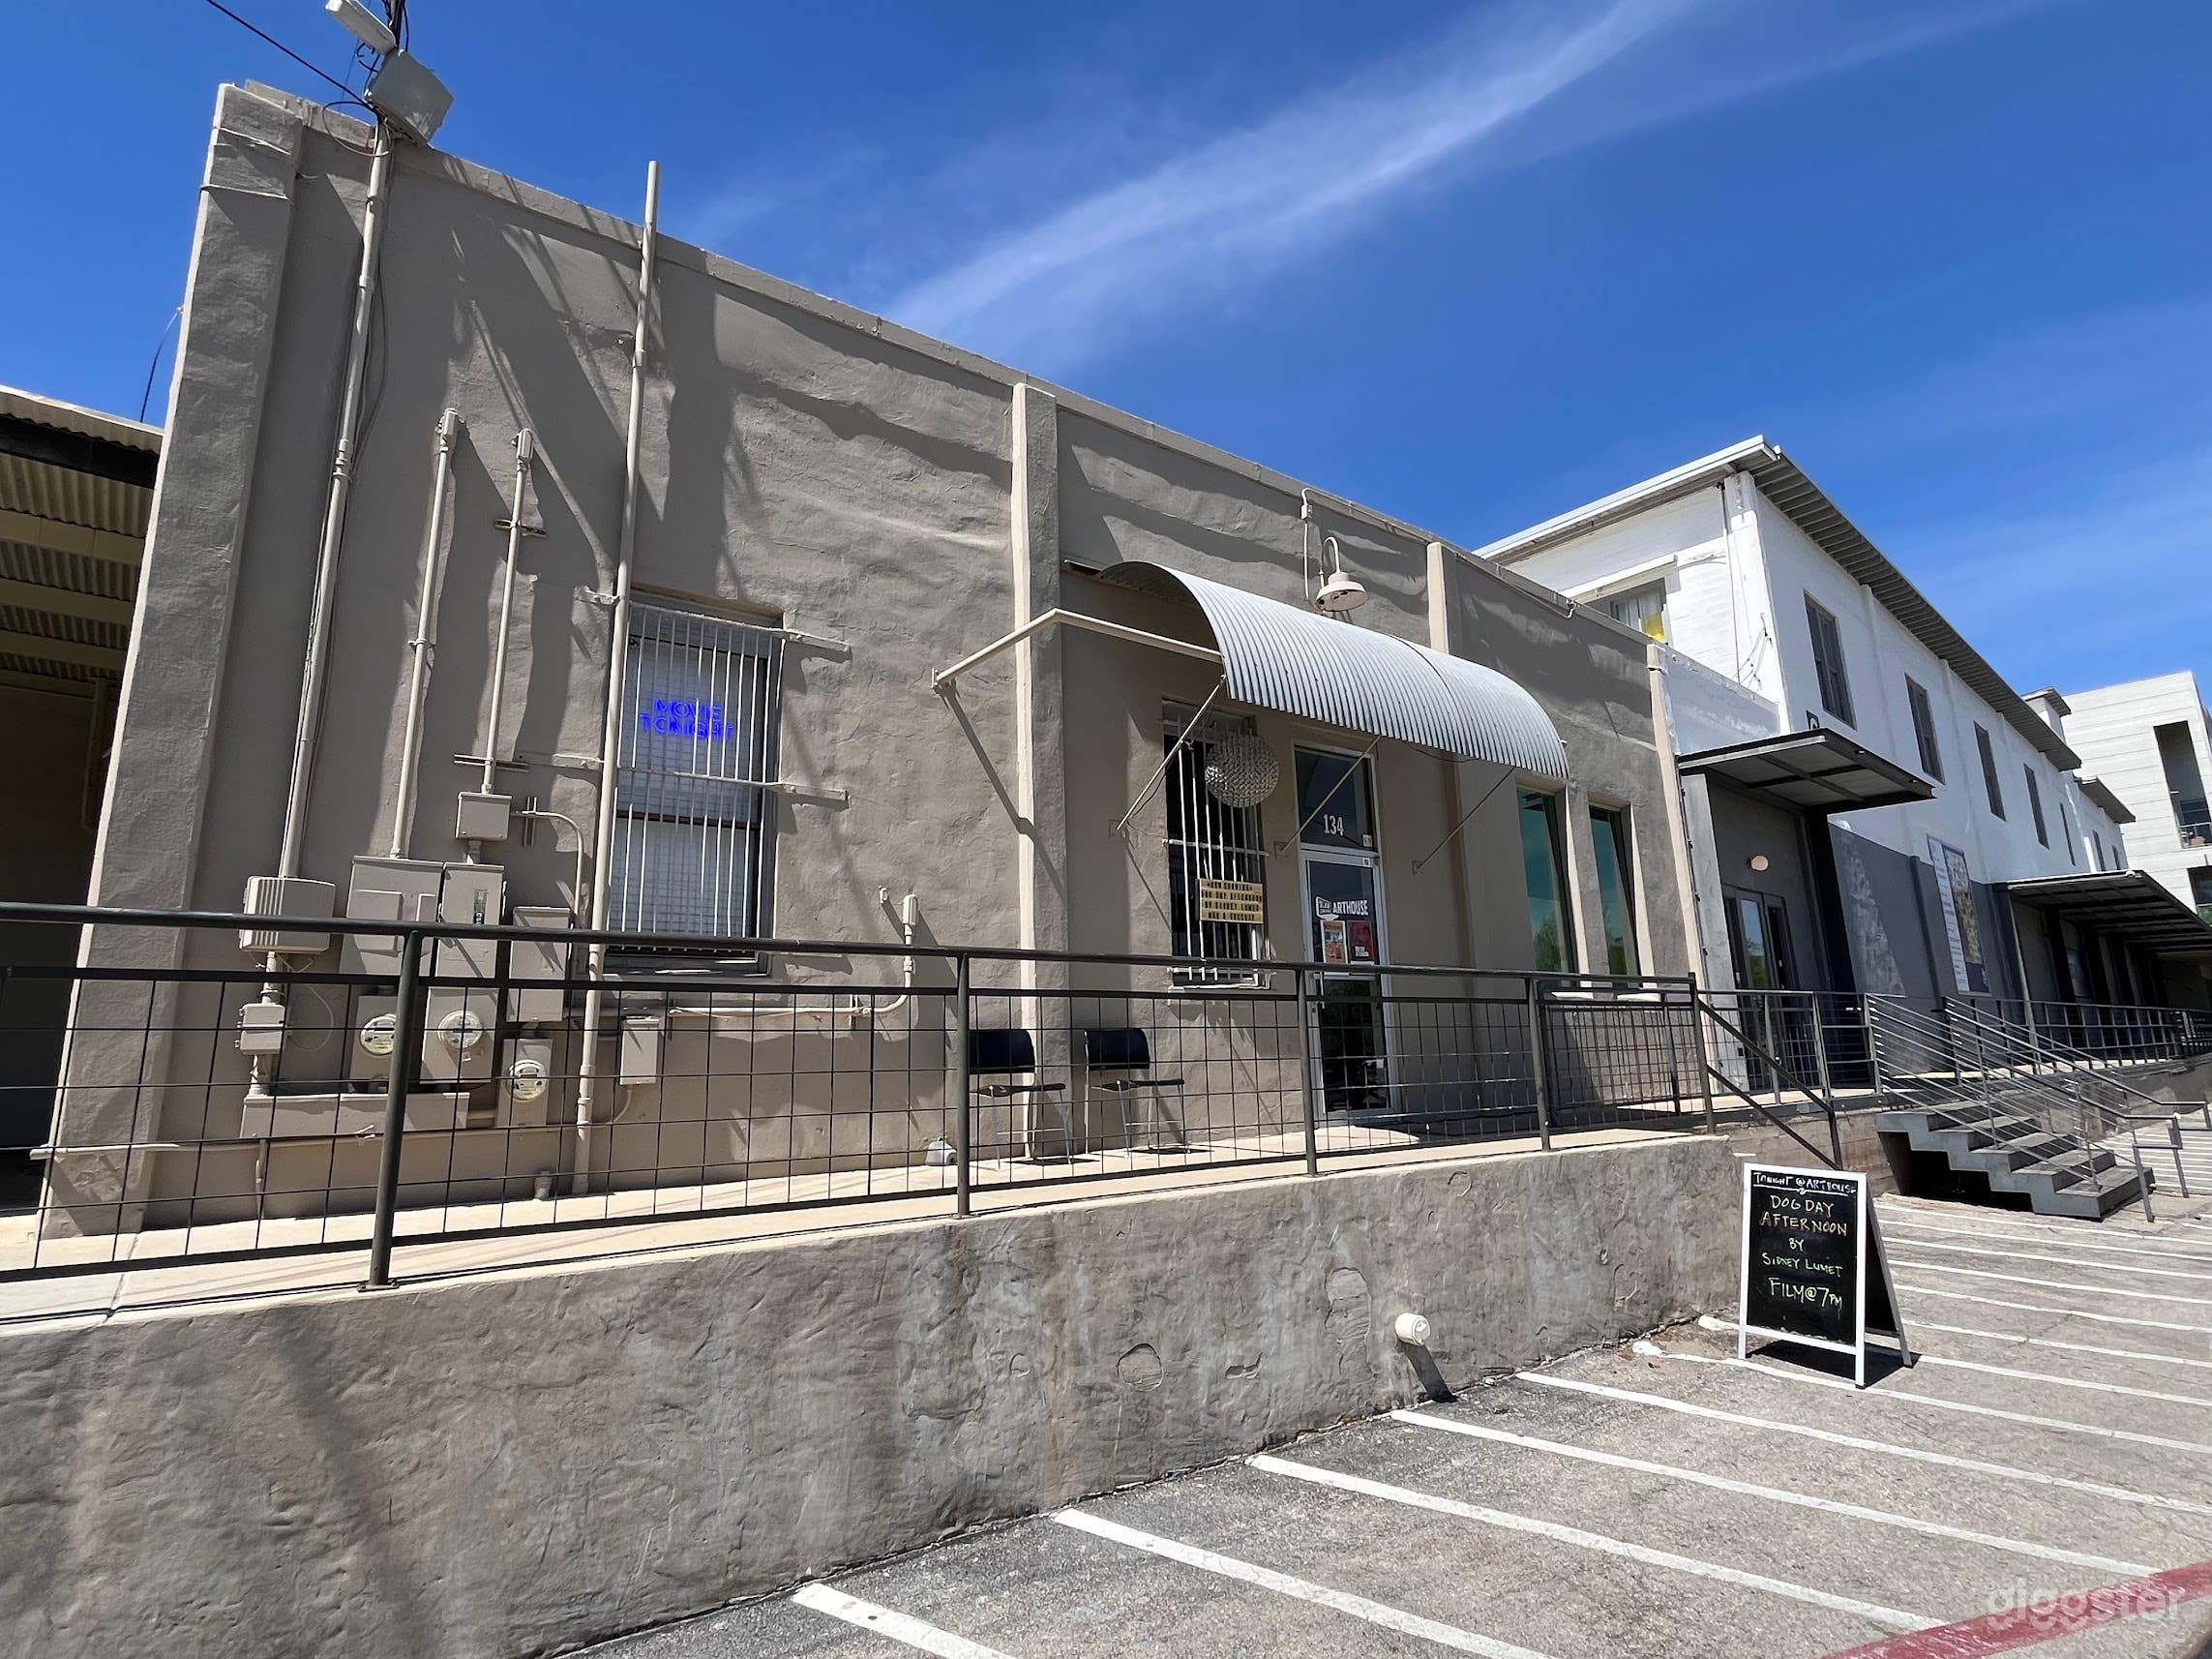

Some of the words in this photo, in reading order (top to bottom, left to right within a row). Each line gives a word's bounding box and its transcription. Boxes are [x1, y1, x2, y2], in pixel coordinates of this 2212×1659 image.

[653, 698, 722, 721] MOVIE
[639, 711, 733, 741] TONIGHT
[1324, 814, 1344, 836] 134
[1332, 899, 1369, 916] ARTHOUSE
[1753, 1172, 1794, 1186] TONIGHT
[1770, 1194, 1801, 1210] DOG
[1805, 1199, 1834, 1218] DAY
[1759, 1211, 1847, 1236] AFTERNOON
[1788, 1237, 1805, 1252] BY
[1761, 1252, 1800, 1269] SIDNEY
[1805, 1258, 1843, 1278] LUMET
